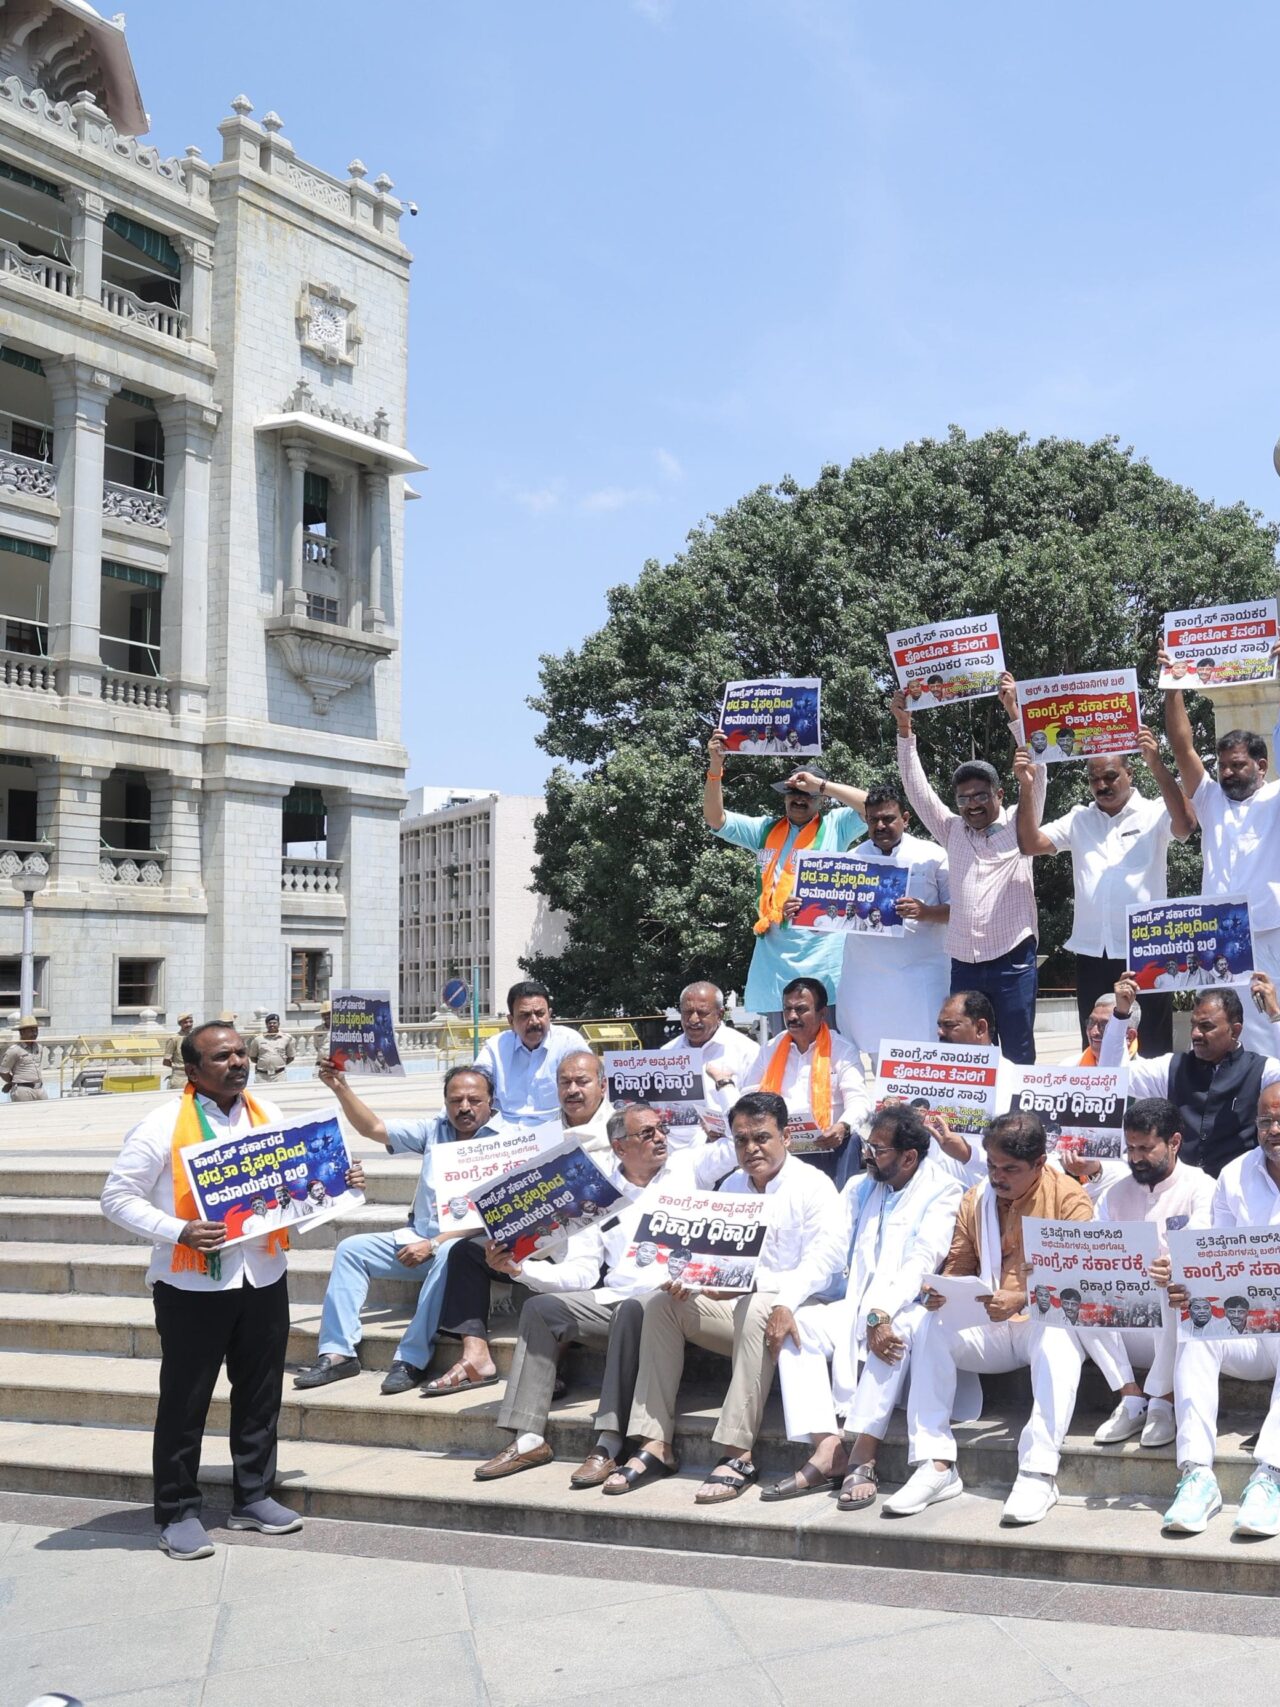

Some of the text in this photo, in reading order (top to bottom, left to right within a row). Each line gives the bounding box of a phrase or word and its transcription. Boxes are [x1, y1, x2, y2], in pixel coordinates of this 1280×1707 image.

[1175, 606, 1267, 628] ಕಾಂಗ್ರೆಸ್ ನಾಯಕರ
[896, 622, 988, 647] ಕಾಂಗ್ರೆಸ್ ನಾಯಕರ
[1178, 623, 1266, 645] ಫೋಟೋ ತೆವಲಿಗೆ
[904, 637, 989, 665] ಫೋಟೋ ತೆವಲಿಗೆ
[1175, 640, 1270, 659] ಅಮಾಯಕರ ಸಾವು
[905, 654, 995, 678] ಅಮಾಯಕರ ಸಾವು
[800, 870, 880, 889] ಭದ್ರತಾ ವೈಫಲ್ಯದಿಂದ
[799, 887, 875, 903] ಅಮಾಯಕರು ಬಲಿ
[1131, 918, 1218, 941] ಭದ್ರತಾ ವೈಫಲ್ಯದಿಂದ
[1132, 937, 1217, 957] ಅಮಾಯಕರು ಬಲಿ
[613, 1056, 648, 1069] ಕಾಂಗ್ರೆಸ್
[890, 1047, 990, 1065] ಕಾಂಗ್ರೆಸ್ ನಾಯಕರ
[614, 1070, 694, 1097] ಧಿಕ್ಕಾರ ಧಿಕ್ಕಾರ
[893, 1064, 986, 1082] ಫೋಟೋ ತೆವಲಿಗೆ
[1023, 1072, 1067, 1087] ಕಾಂಗ್ರೆಸ್
[887, 1083, 988, 1104] ಅಮಾಯಕರ ಸಾವು
[1019, 1089, 1069, 1120] ಧಿಕ್ಕಾರ
[1071, 1091, 1117, 1123] ಧಿಕ್ಕಾರ
[193, 1132, 284, 1168] ಕಾಂಗ್ರೆಸ್ ಸರ್ಕಾರದ
[197, 1142, 306, 1188] ಭದ್ರತಾ ವೈಫಲ್ಯದಿಂದ
[444, 1162, 499, 1182] ಕಾಂಗ್ರೆಸ್
[204, 1162, 309, 1206] ಅಮಾಯಕರು ಬಲಿ
[484, 1173, 566, 1225] ಭದ್ರತಾ ವೈಫಲ್ಯದಿಂದ
[658, 1195, 709, 1211] ಕಾಂಗ್ರೆಸ್
[493, 1189, 576, 1242] ಅಮಾಯಕರು ಬಲಿ
[648, 1210, 760, 1251] ಧಿಕ್ಕಾರ ಧಿಕ್ಕಾರ
[1031, 1252, 1148, 1277] ಕಾಂಗ್ರೆಸ್ ಸರ್ಕಾರಕ್ಕೆ
[1183, 1260, 1246, 1282] ಕಾಂಗ್ರೆಸ್
[1079, 1279, 1157, 1297] ಧಿಕ್ಕಾರ ಧಿಕ್ಕಾರ..
